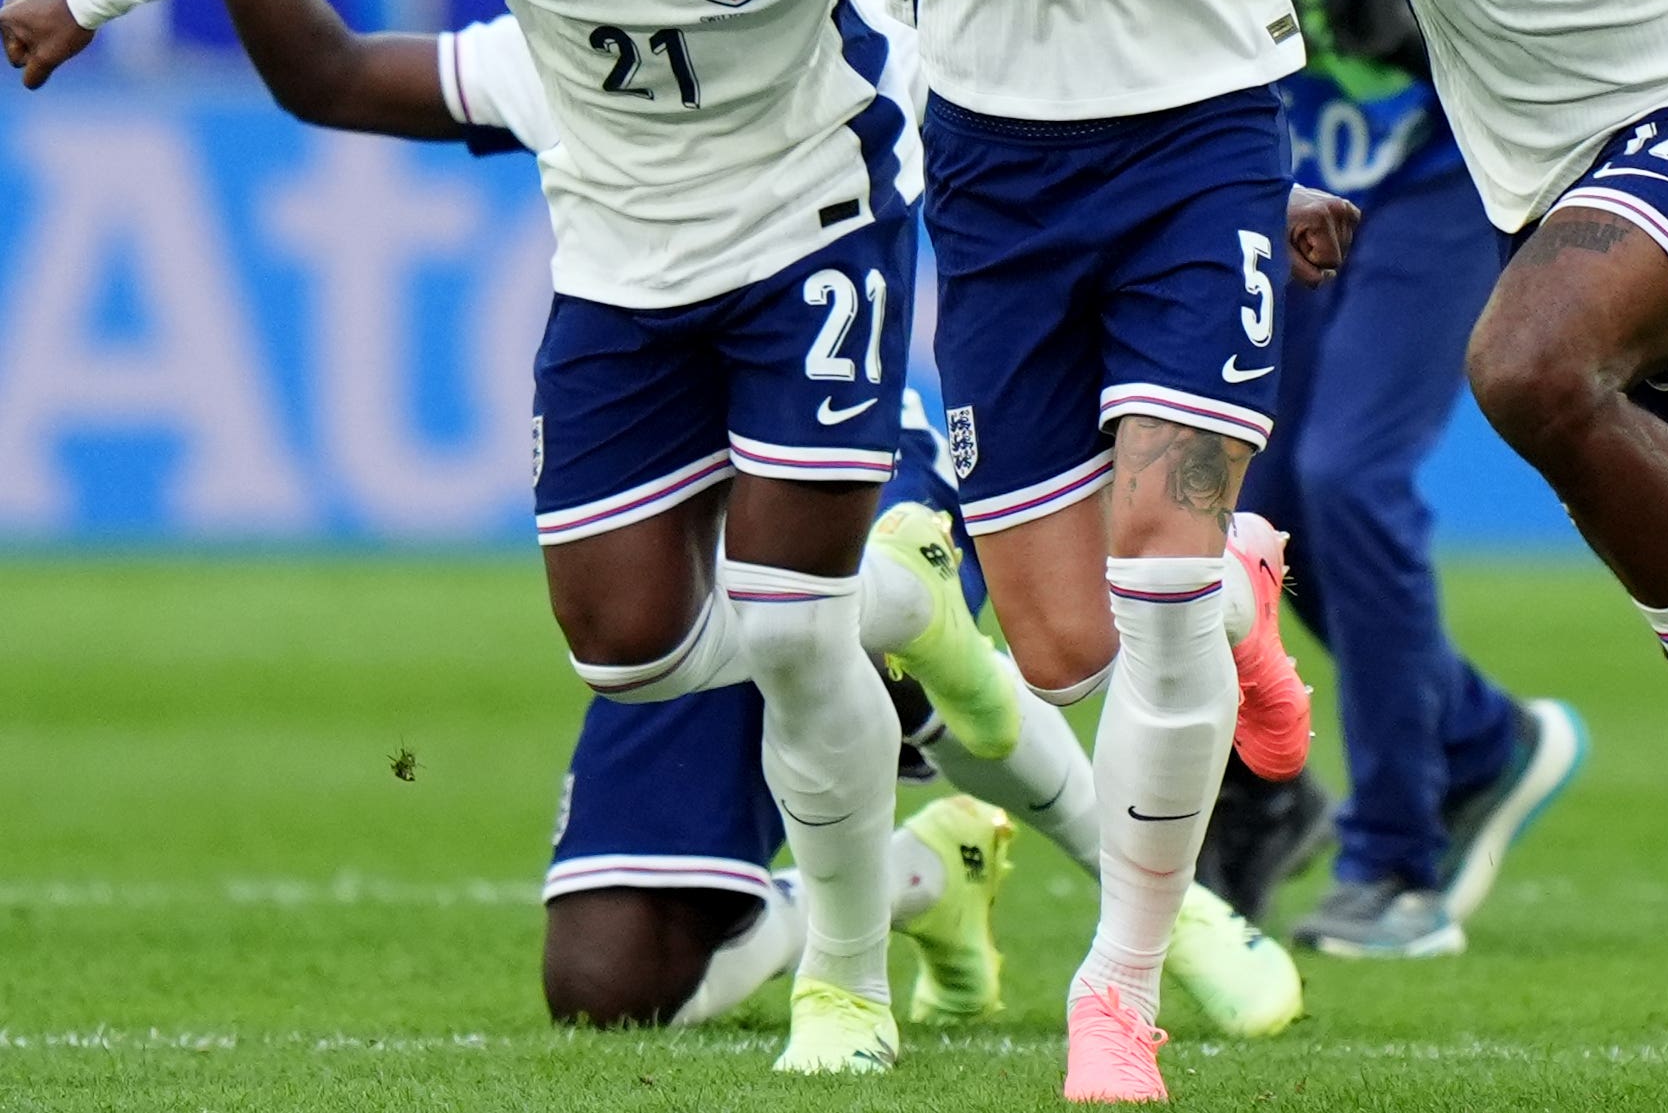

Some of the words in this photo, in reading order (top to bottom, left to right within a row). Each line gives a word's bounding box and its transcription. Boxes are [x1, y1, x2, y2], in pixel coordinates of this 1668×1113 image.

[589, 25, 701, 110] 21
[802, 267, 888, 385] 21
[1237, 228, 1274, 348] 5
